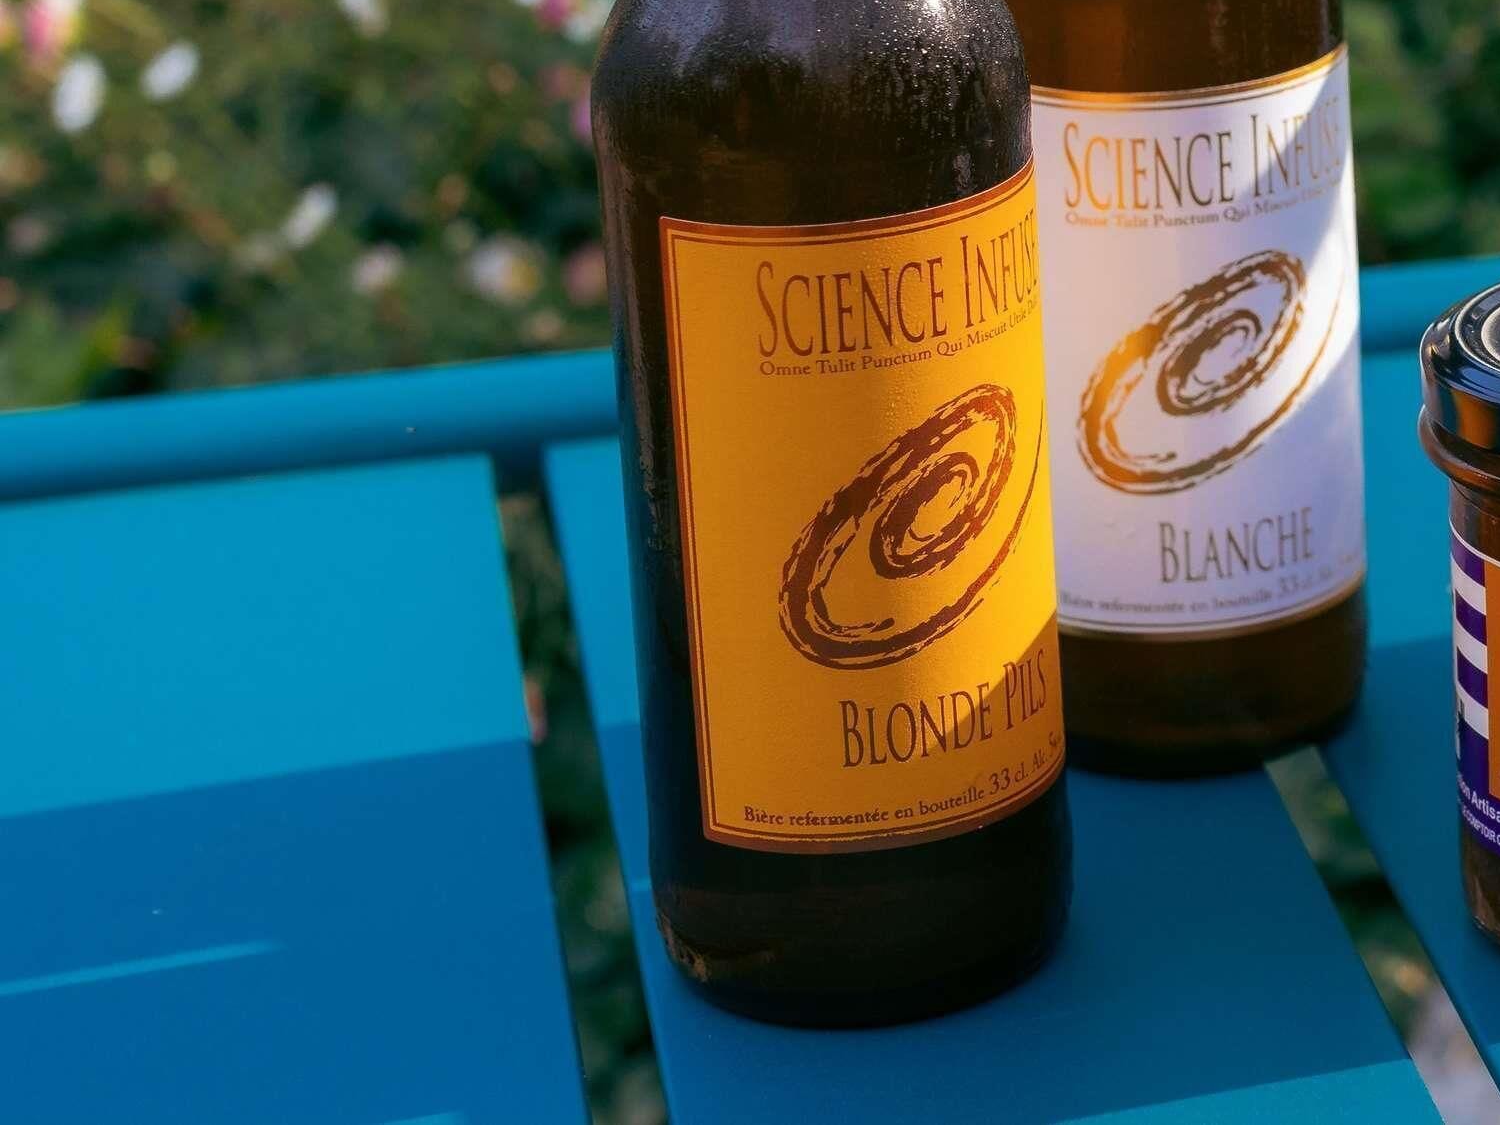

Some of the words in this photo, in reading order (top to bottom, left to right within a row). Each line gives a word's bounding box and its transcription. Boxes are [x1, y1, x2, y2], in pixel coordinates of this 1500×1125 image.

[1063, 122, 1234, 210] SCIENCE
[757, 259, 948, 359] SCIENCE
[760, 360, 811, 377] Omne
[817, 359, 856, 375] Tulit
[862, 349, 932, 370] Punctum
[937, 340, 963, 358] Qui
[967, 322, 1007, 348] Miscuit
[1159, 506, 1314, 583] BLANCHE
[839, 682, 993, 768] BLONDE
[1002, 648, 1047, 731] PILS
[744, 806, 784, 826] Bière
[789, 808, 889, 826] refermentée
[895, 805, 914, 819] en
[919, 786, 986, 813] bouteille
[989, 767, 1010, 795] 33
